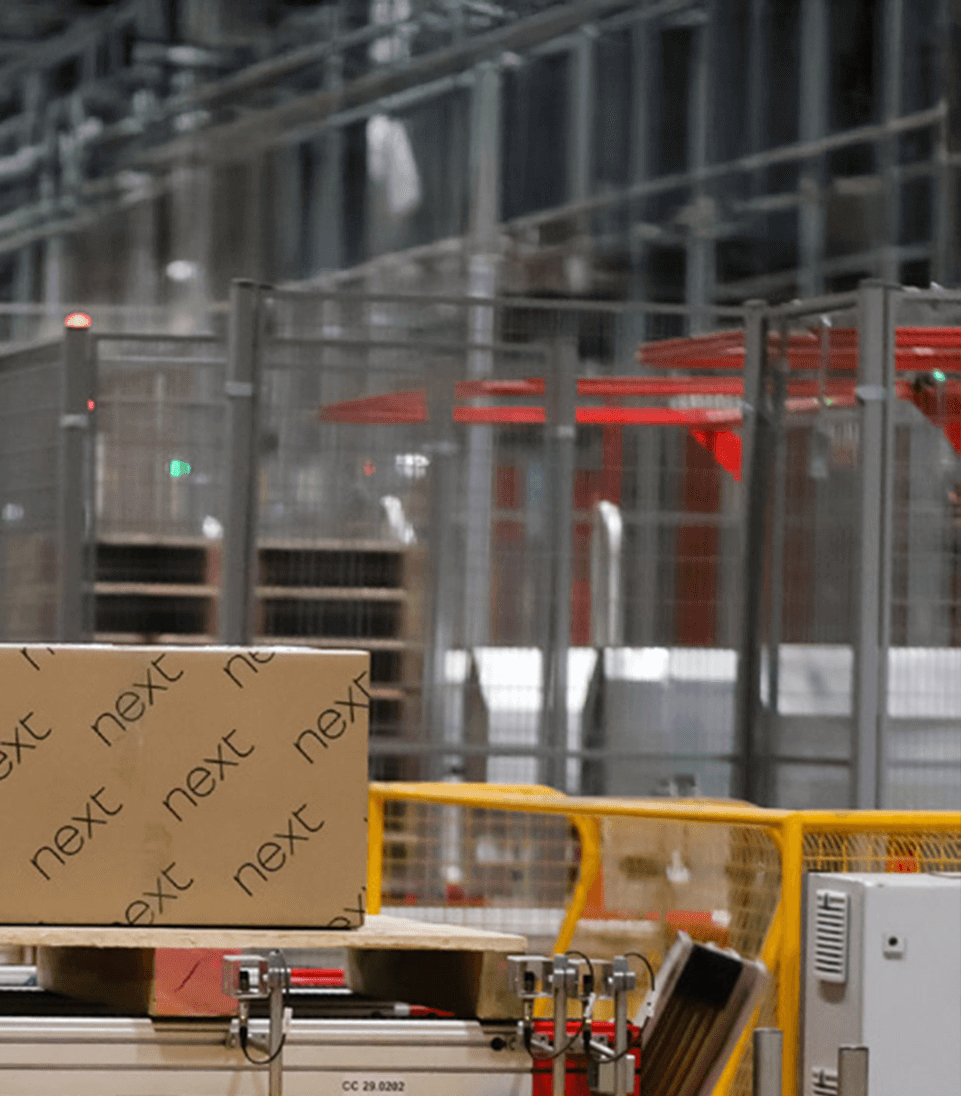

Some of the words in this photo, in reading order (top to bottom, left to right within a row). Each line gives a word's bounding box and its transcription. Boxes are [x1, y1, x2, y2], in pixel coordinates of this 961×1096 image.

[90, 652, 184, 747] next
[162, 728, 256, 822] next
[29, 785, 124, 881] next
[232, 802, 326, 897] next
[341, 1080, 359, 1092] CC
